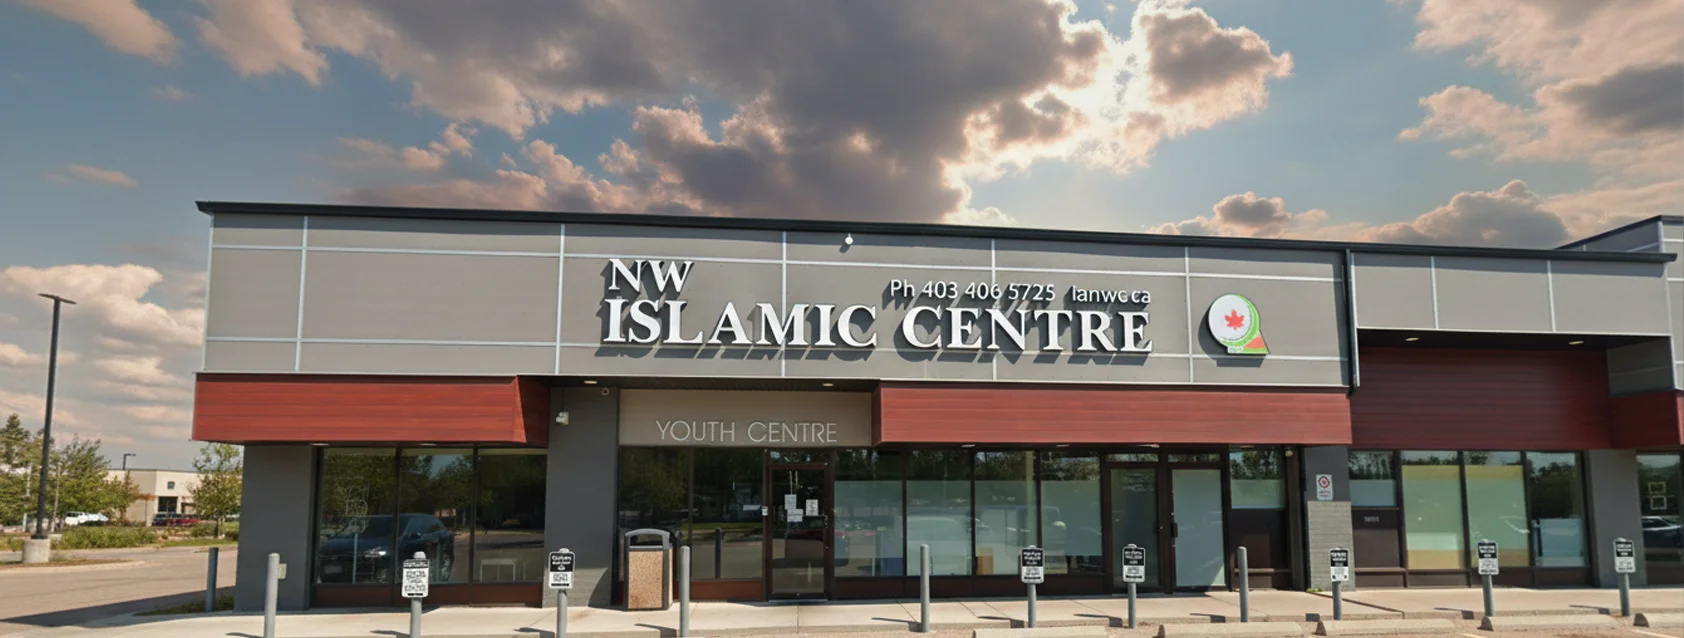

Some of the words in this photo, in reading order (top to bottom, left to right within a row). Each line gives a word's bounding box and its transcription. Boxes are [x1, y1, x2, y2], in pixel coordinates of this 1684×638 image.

[608, 258, 693, 292] NW
[890, 279, 915, 297] Ph
[922, 281, 957, 298] 403
[965, 282, 1001, 299] 406
[1008, 284, 1055, 301] 5725
[604, 298, 877, 347] ISLAMIC
[903, 305, 1152, 352] CENTRE
[656, 420, 735, 442] YOUTH
[748, 421, 836, 442] CENTRE
